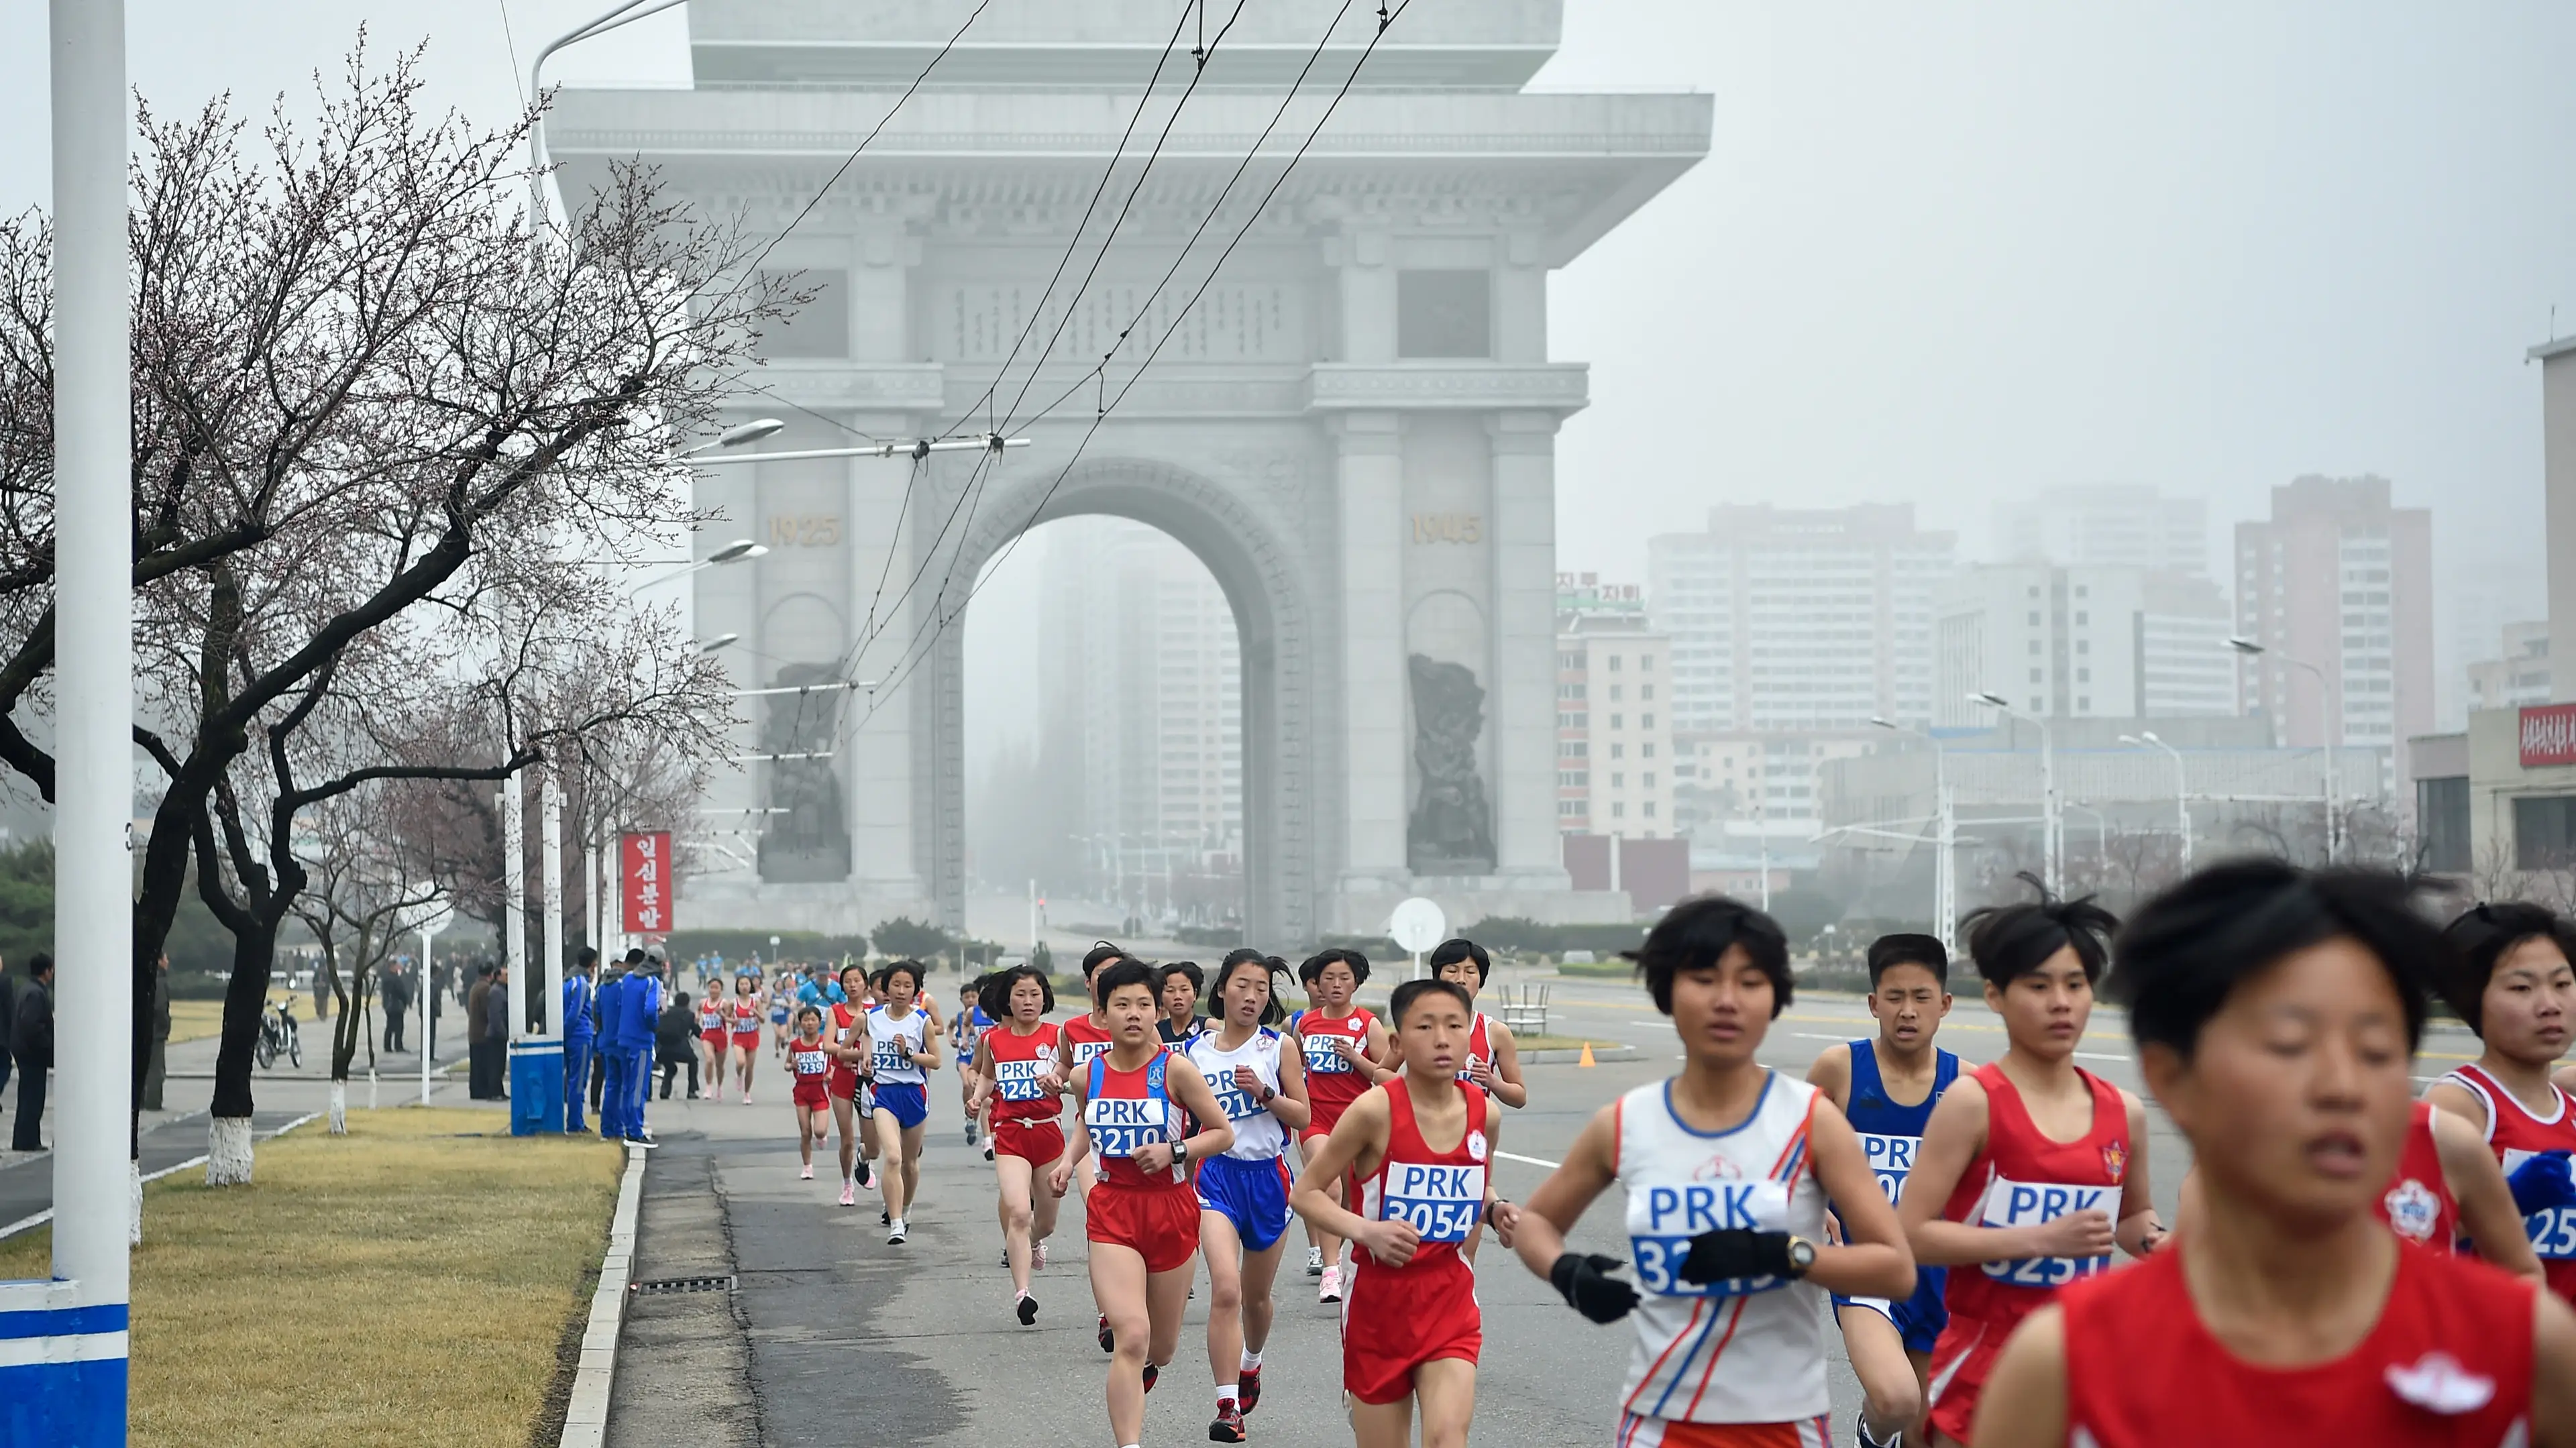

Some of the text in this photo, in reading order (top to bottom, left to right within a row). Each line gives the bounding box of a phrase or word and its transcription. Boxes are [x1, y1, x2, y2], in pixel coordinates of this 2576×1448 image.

[767, 516, 841, 546] 1925
[1410, 513, 1481, 545] 1945
[877, 1041, 895, 1053] PR
[1310, 1036, 1334, 1050] PR
[798, 1062, 824, 1074] 3239
[799, 1052, 819, 1062] PRK
[873, 1055, 913, 1070] 3216
[1002, 1062, 1037, 1079] PRK
[1203, 1070, 1237, 1091] PR
[1096, 1101, 1150, 1123] PRK
[1089, 1128, 1160, 1155] 3210
[1865, 1137, 1921, 1168] PR
[1403, 1167, 1471, 1197] PRK
[1651, 1185, 1759, 1231] PRK
[2008, 1186, 2102, 1224] PRK
[1389, 1201, 1474, 1239] 3054
[2529, 1208, 2576, 1255] 25
